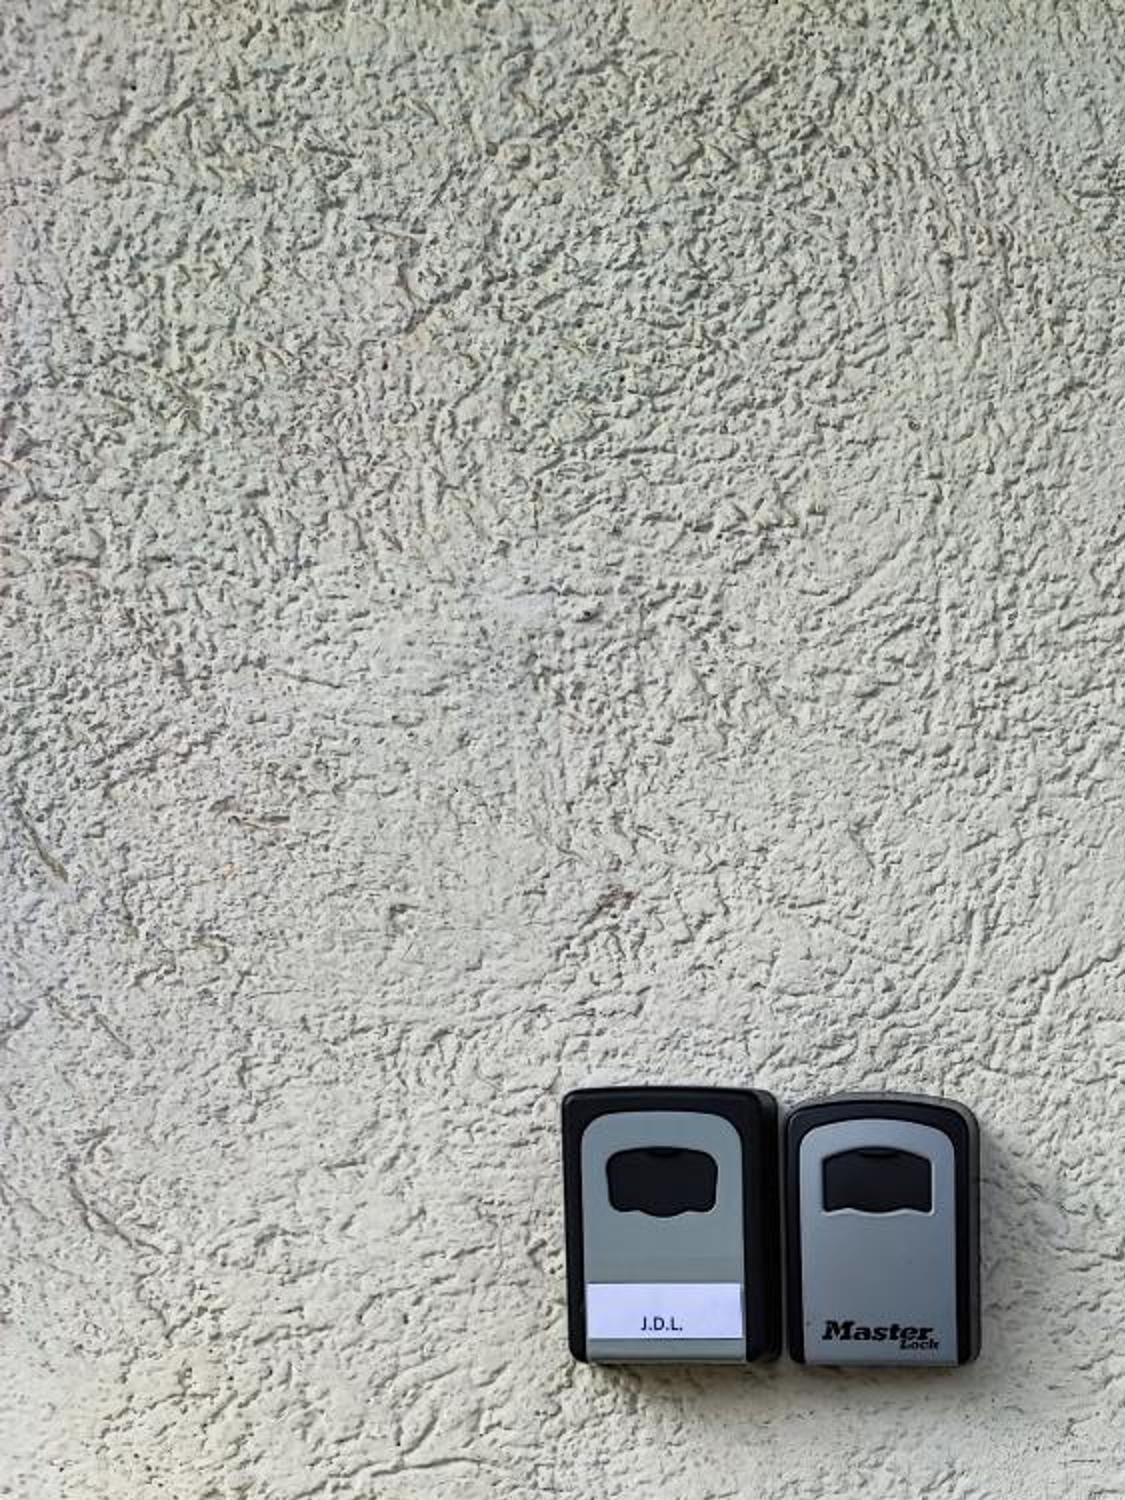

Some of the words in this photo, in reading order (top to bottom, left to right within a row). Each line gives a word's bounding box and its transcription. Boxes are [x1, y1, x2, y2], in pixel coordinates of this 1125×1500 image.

[640, 1314, 683, 1332] J.D.L.
[821, 1320, 933, 1341] Master
[900, 1337, 940, 1351] Lock
